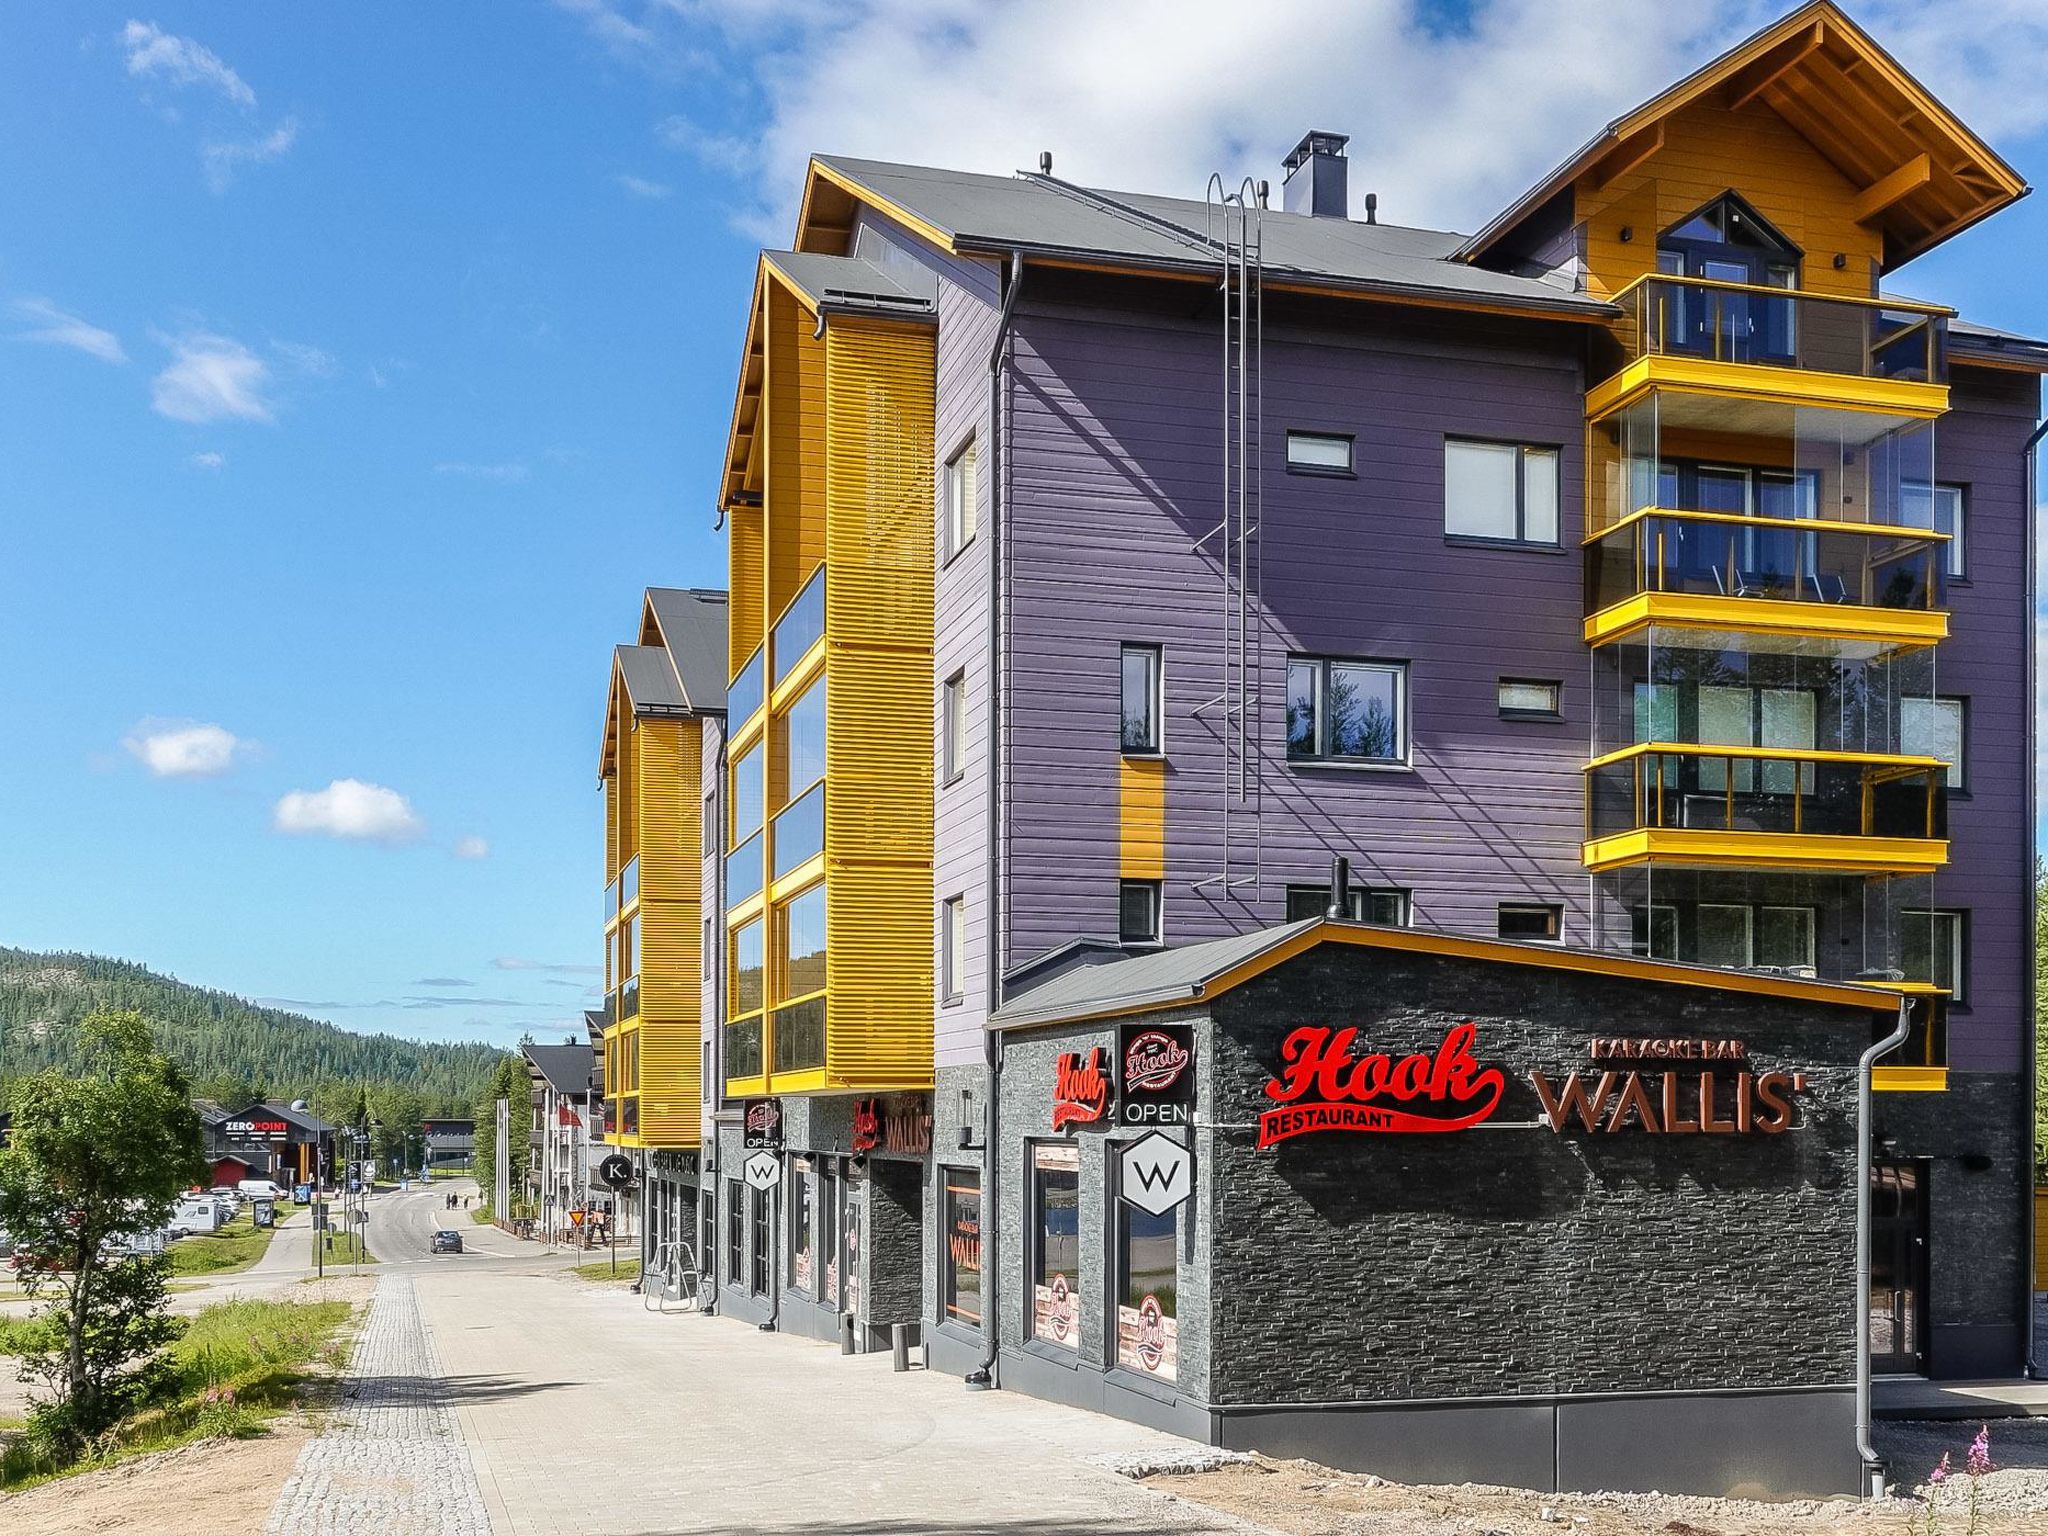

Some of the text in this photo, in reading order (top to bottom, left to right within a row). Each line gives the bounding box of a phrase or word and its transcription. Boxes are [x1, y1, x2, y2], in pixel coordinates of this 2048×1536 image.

[1126, 1040, 1188, 1082] Hook
[1265, 1022, 1500, 1101] Hook
[1590, 1038, 1745, 1060] KARAOKE BAR
[1054, 1046, 1105, 1100] Hook
[1126, 1103, 1188, 1122] OPEN
[1528, 1071, 1808, 1134] WALLIS'
[1266, 1108, 1396, 1139] RESTAURANT
[750, 1164, 775, 1180] W
[1132, 1160, 1181, 1193] W
